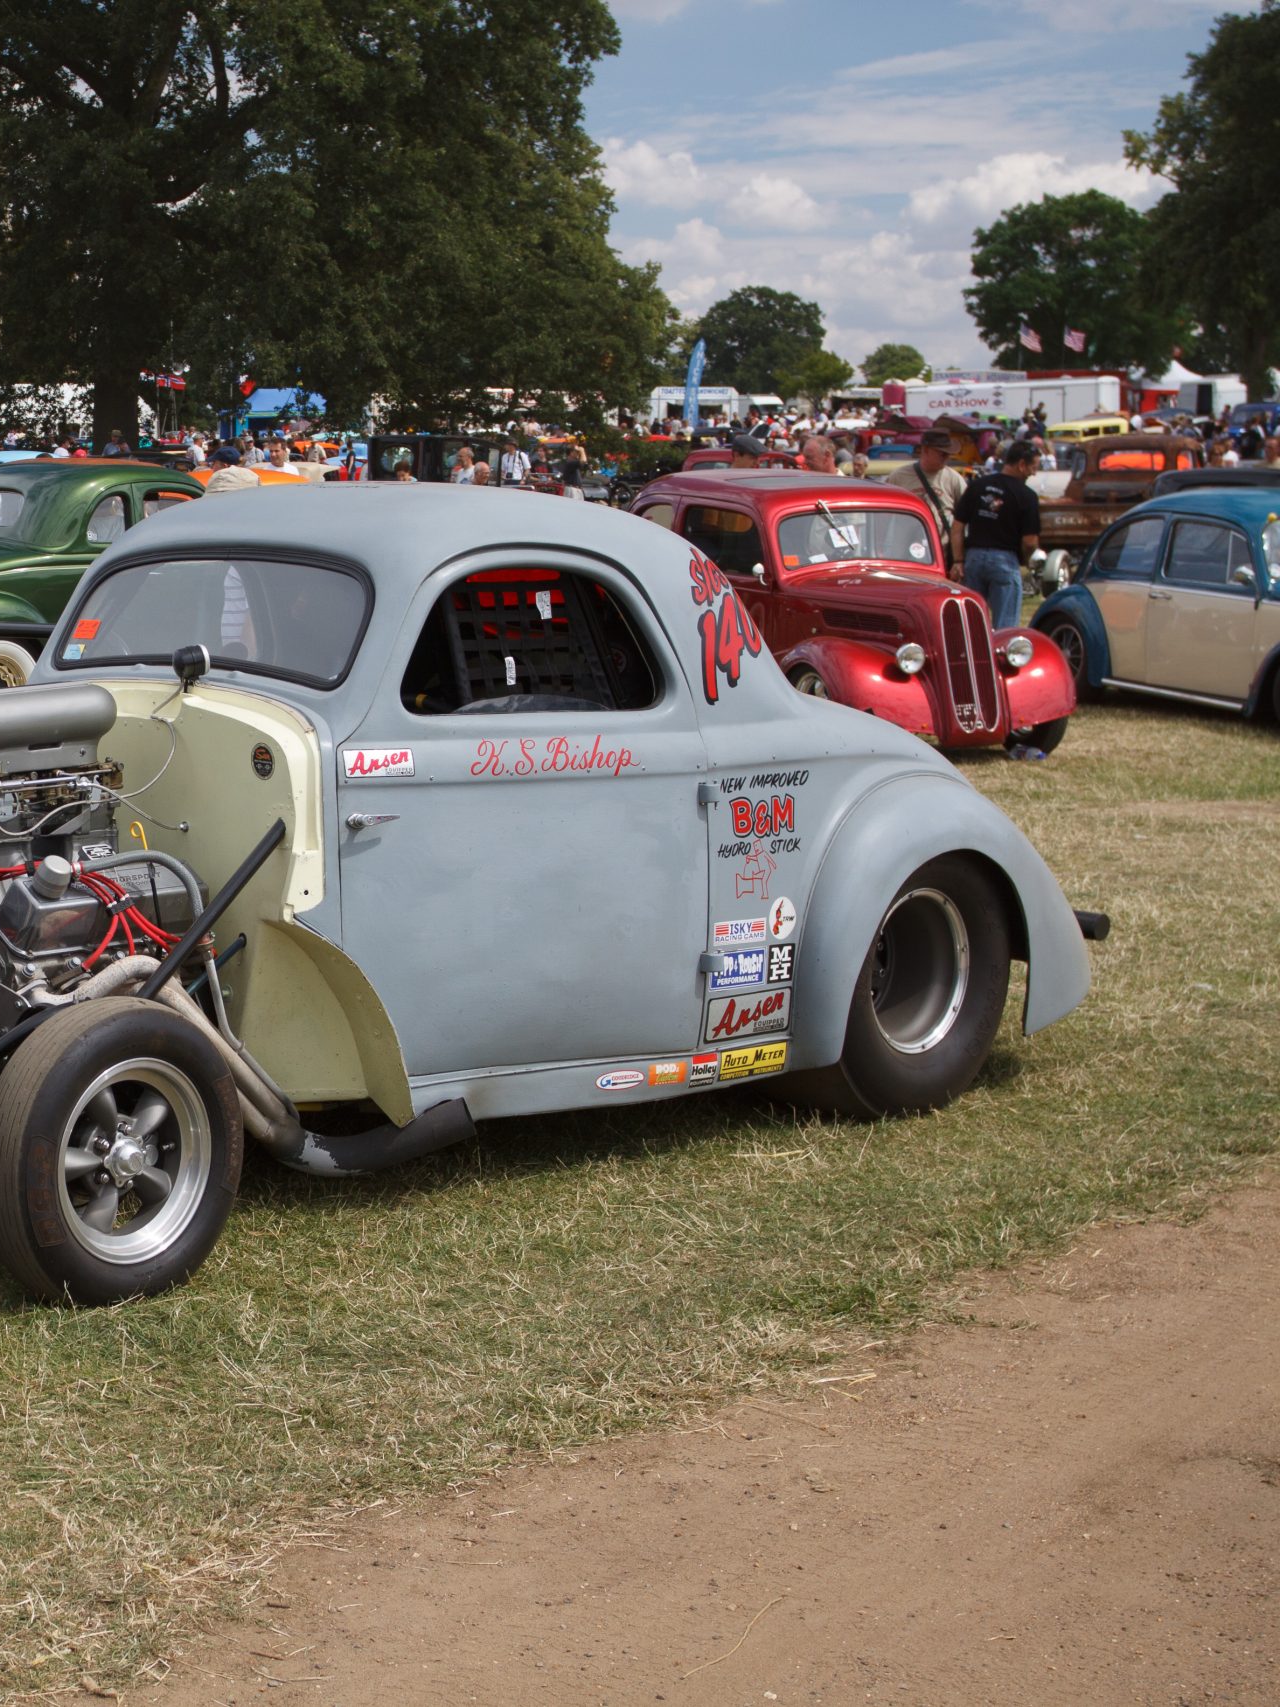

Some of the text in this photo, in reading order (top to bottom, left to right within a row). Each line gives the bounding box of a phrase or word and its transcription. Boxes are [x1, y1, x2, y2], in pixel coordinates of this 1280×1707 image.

[929, 398, 989, 409] CAR SHOW
[348, 751, 409, 775] Ansen
[720, 770, 810, 794] NEW IMPROVED
[729, 793, 795, 839] B&M
[718, 838, 802, 858] HYDRO STICK
[715, 931, 765, 943] RACING CAMS
[730, 922, 753, 935] ISKY
[738, 953, 764, 975] ROUGH
[717, 974, 760, 986] PERFORMANCE
[712, 991, 785, 1039] Ansen
[723, 1048, 785, 1068] AUTO METER
[691, 1064, 717, 1076] Holley
